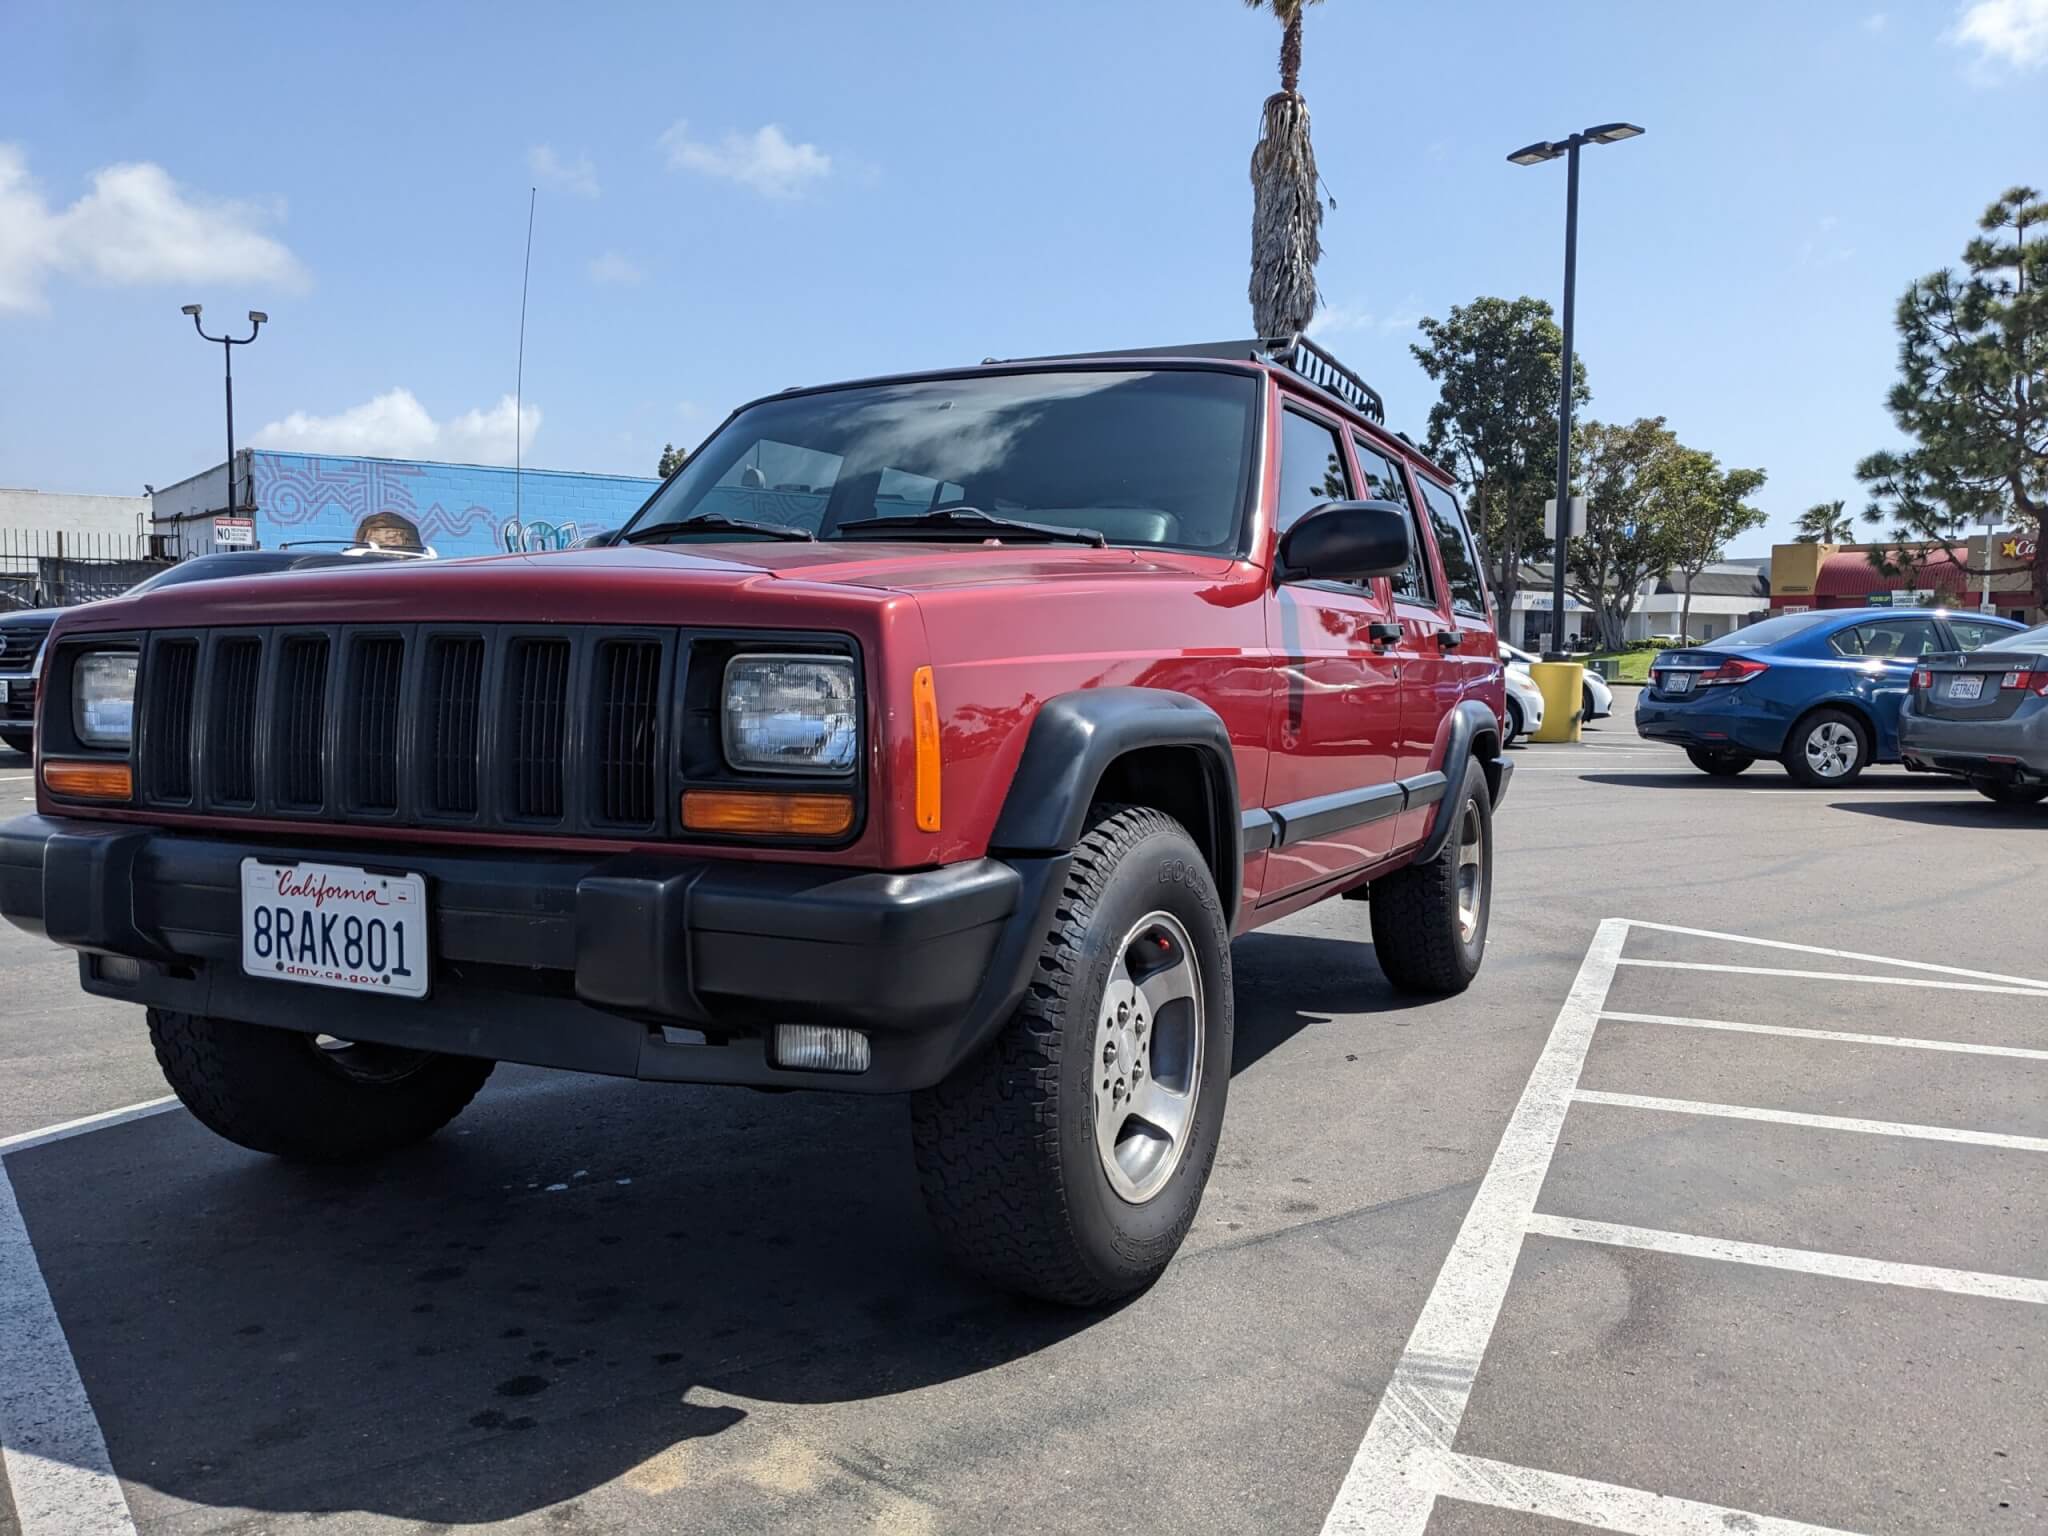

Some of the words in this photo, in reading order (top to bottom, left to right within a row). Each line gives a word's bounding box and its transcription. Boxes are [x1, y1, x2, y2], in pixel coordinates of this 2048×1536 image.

[217, 527, 231, 541] NO
[276, 869, 390, 908] California
[254, 905, 412, 977] 8RAK801
[286, 965, 380, 985] dmv.ca.gov
